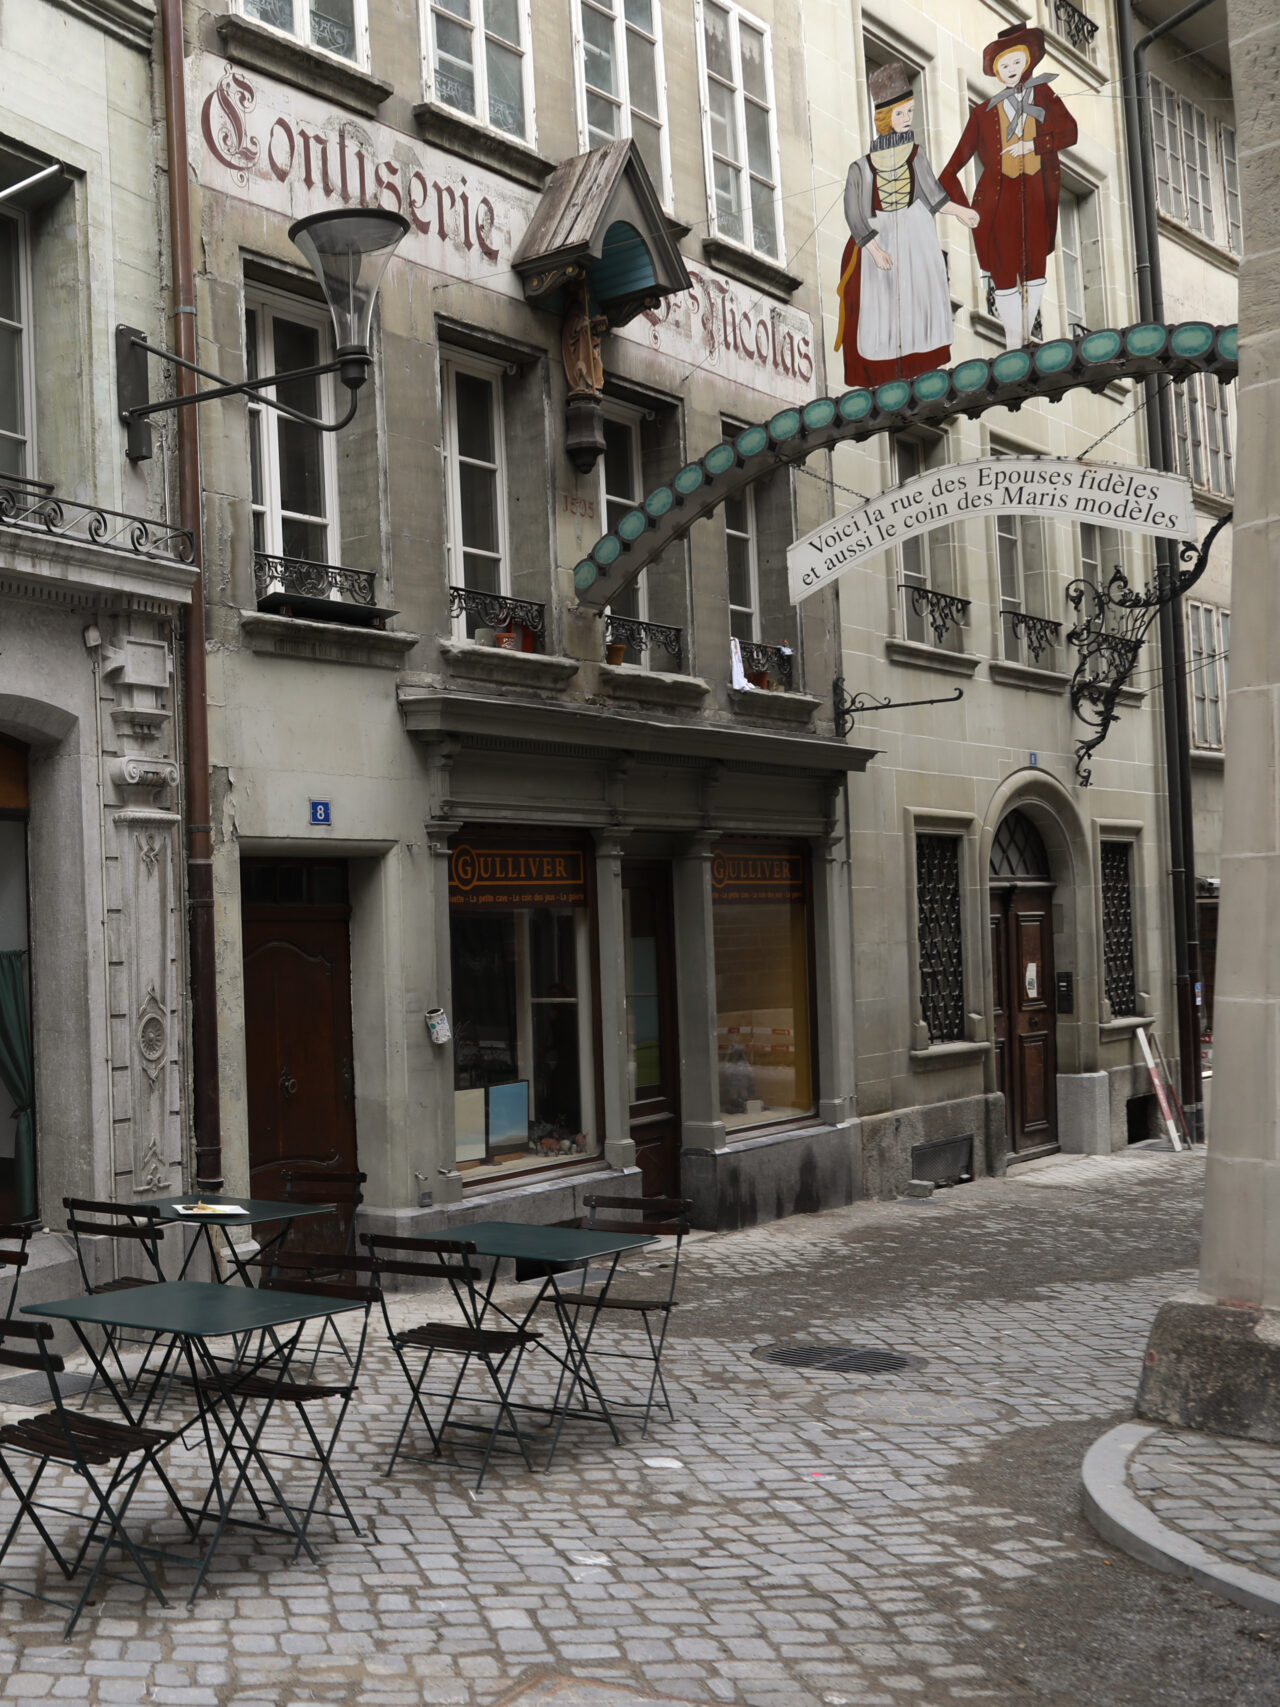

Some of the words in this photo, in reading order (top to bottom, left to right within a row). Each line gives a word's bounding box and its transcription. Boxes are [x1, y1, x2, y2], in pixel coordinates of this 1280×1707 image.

[808, 516, 860, 554] Voici
[864, 508, 885, 526] la
[890, 491, 924, 514] rue
[931, 476, 967, 498] des
[978, 466, 1073, 490] Epouses
[1077, 469, 1160, 500] fidèles
[802, 566, 821, 586] et
[824, 531, 873, 571] aussi
[877, 523, 897, 541] le
[904, 502, 948, 528] coin
[957, 491, 993, 512] des
[1002, 486, 1069, 508] Maris
[1074, 497, 1179, 529] modèles
[317, 805, 325, 820] 8
[458, 855, 568, 879] GULLIVER
[713, 858, 792, 879] GULLIVER
